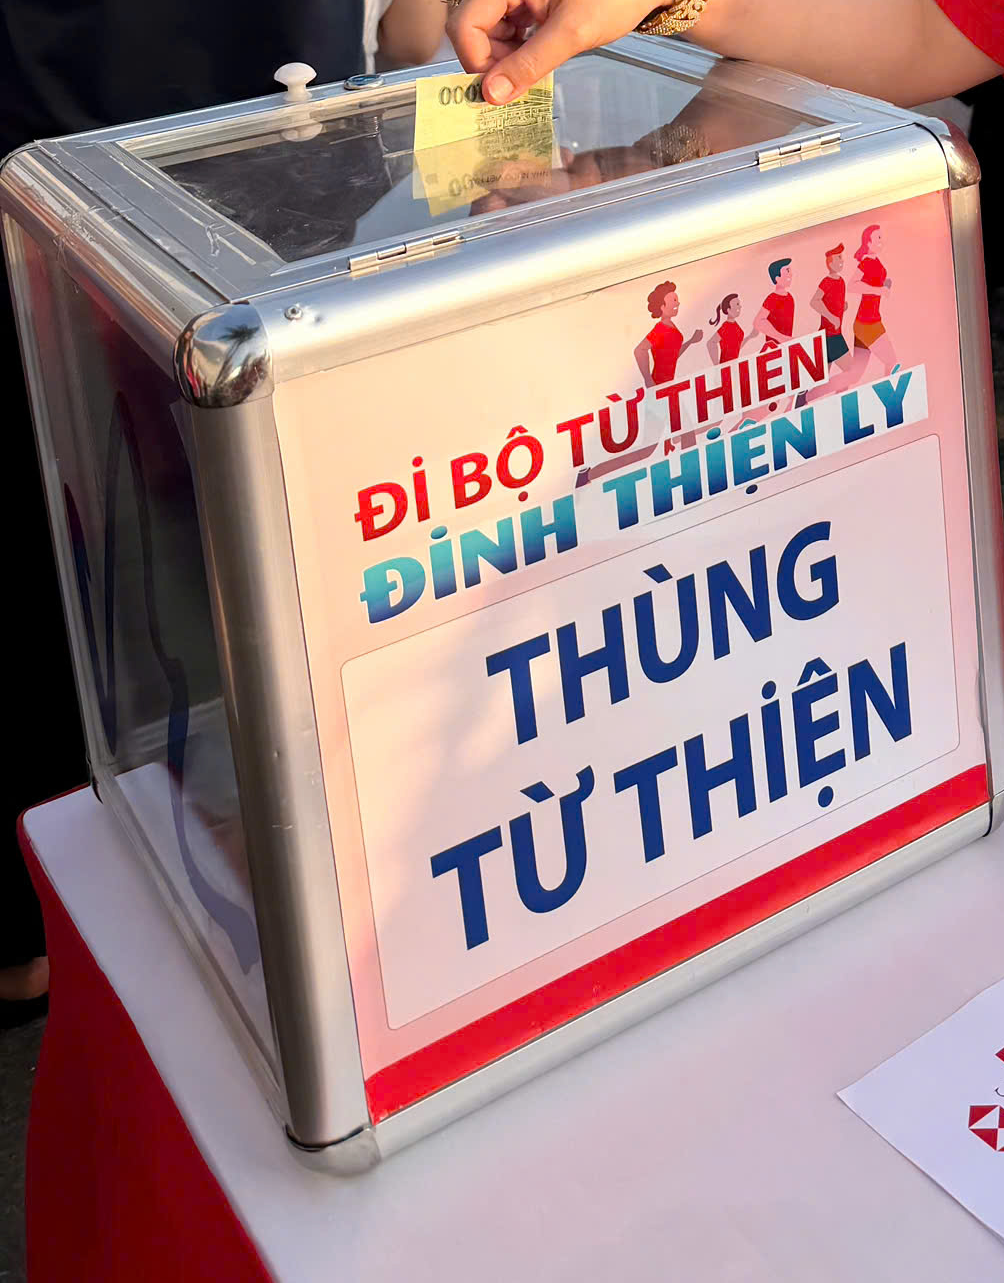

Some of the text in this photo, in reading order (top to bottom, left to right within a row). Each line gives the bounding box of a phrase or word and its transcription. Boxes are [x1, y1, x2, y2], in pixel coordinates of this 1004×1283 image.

[354, 334, 827, 542] ĐI BỘ TỪ THIỆN
[360, 364, 913, 624] ĐINH THIỆN LÝ
[486, 521, 840, 745] THÙNG
[430, 642, 912, 950] TỪ THIỆN
